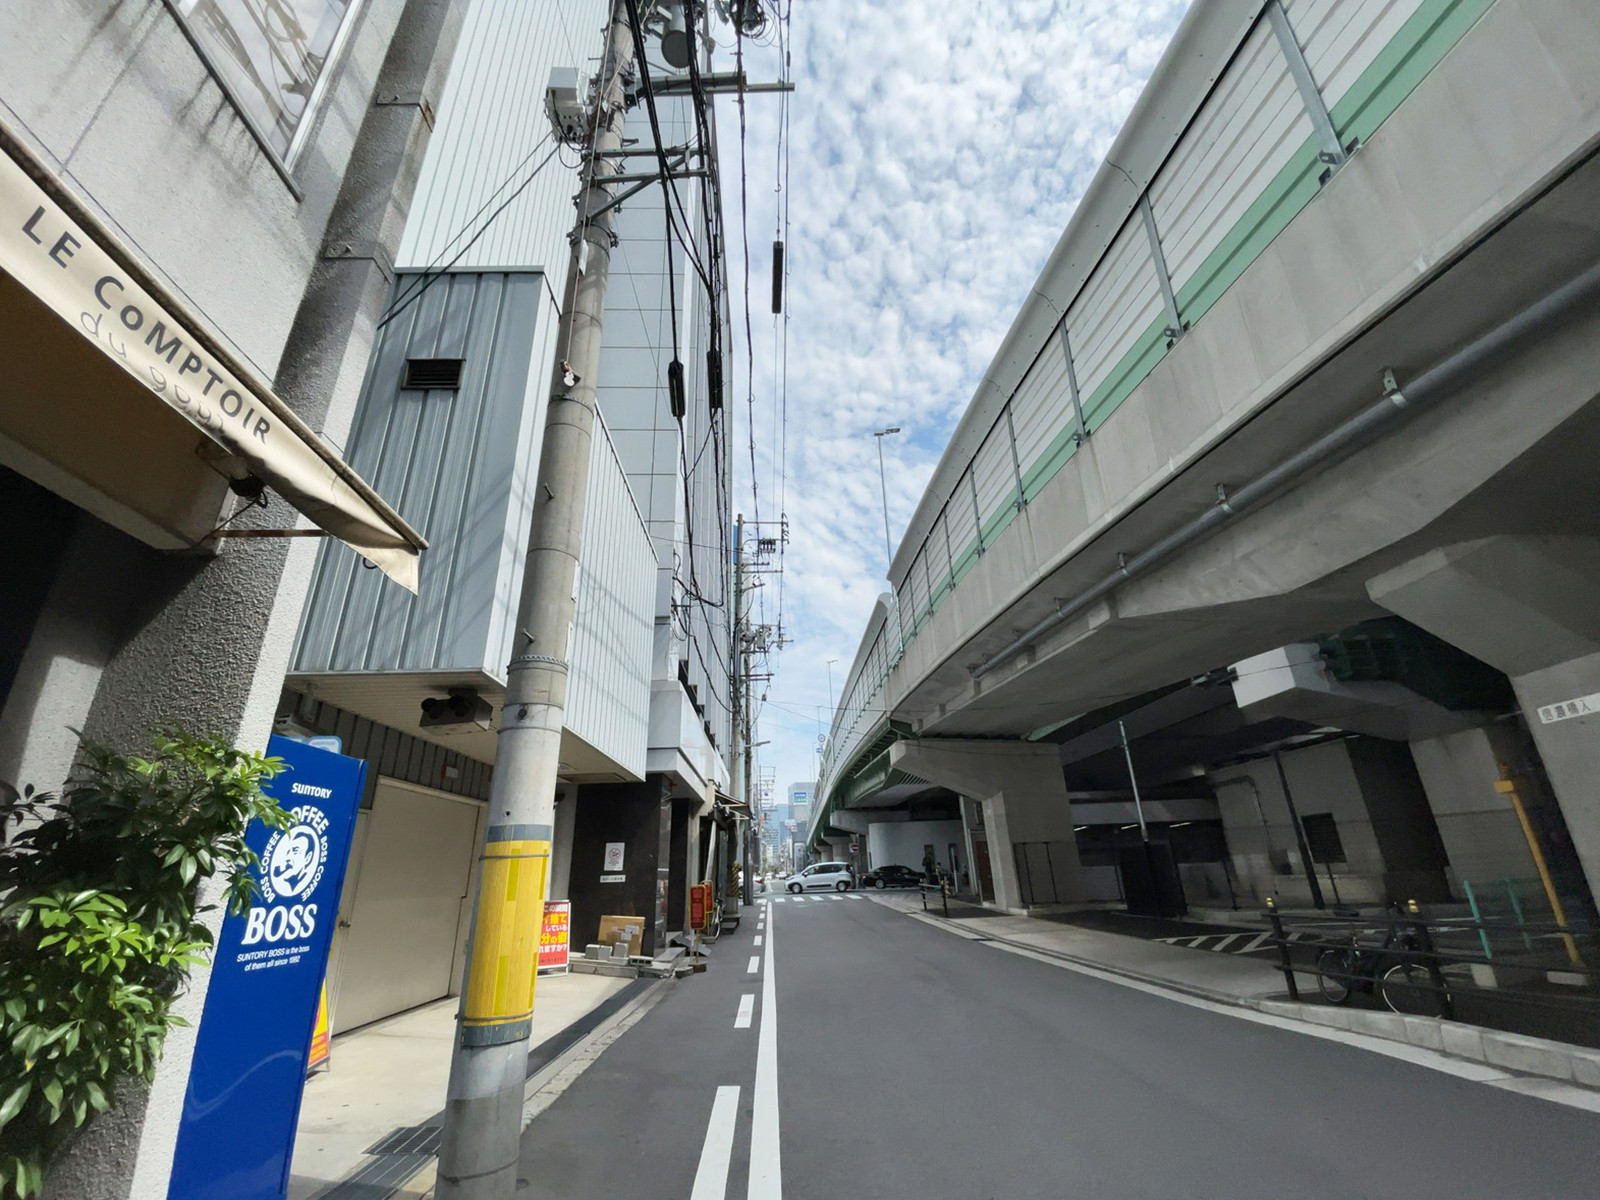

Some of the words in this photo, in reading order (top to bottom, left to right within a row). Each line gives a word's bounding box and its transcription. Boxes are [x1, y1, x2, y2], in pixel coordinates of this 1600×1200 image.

[22, 204, 82, 270] LE
[80, 311, 127, 359] du
[291, 782, 333, 799] SUNTORY
[260, 831, 281, 875] COFFEE
[320, 835, 329, 863] BOSS
[260, 876, 276, 904] BOSS
[301, 865, 325, 902] COFFEE
[240, 903, 318, 945] BOSS
[236, 951, 269, 963] SUNTORY
[268, 947, 286, 958] BOSS
